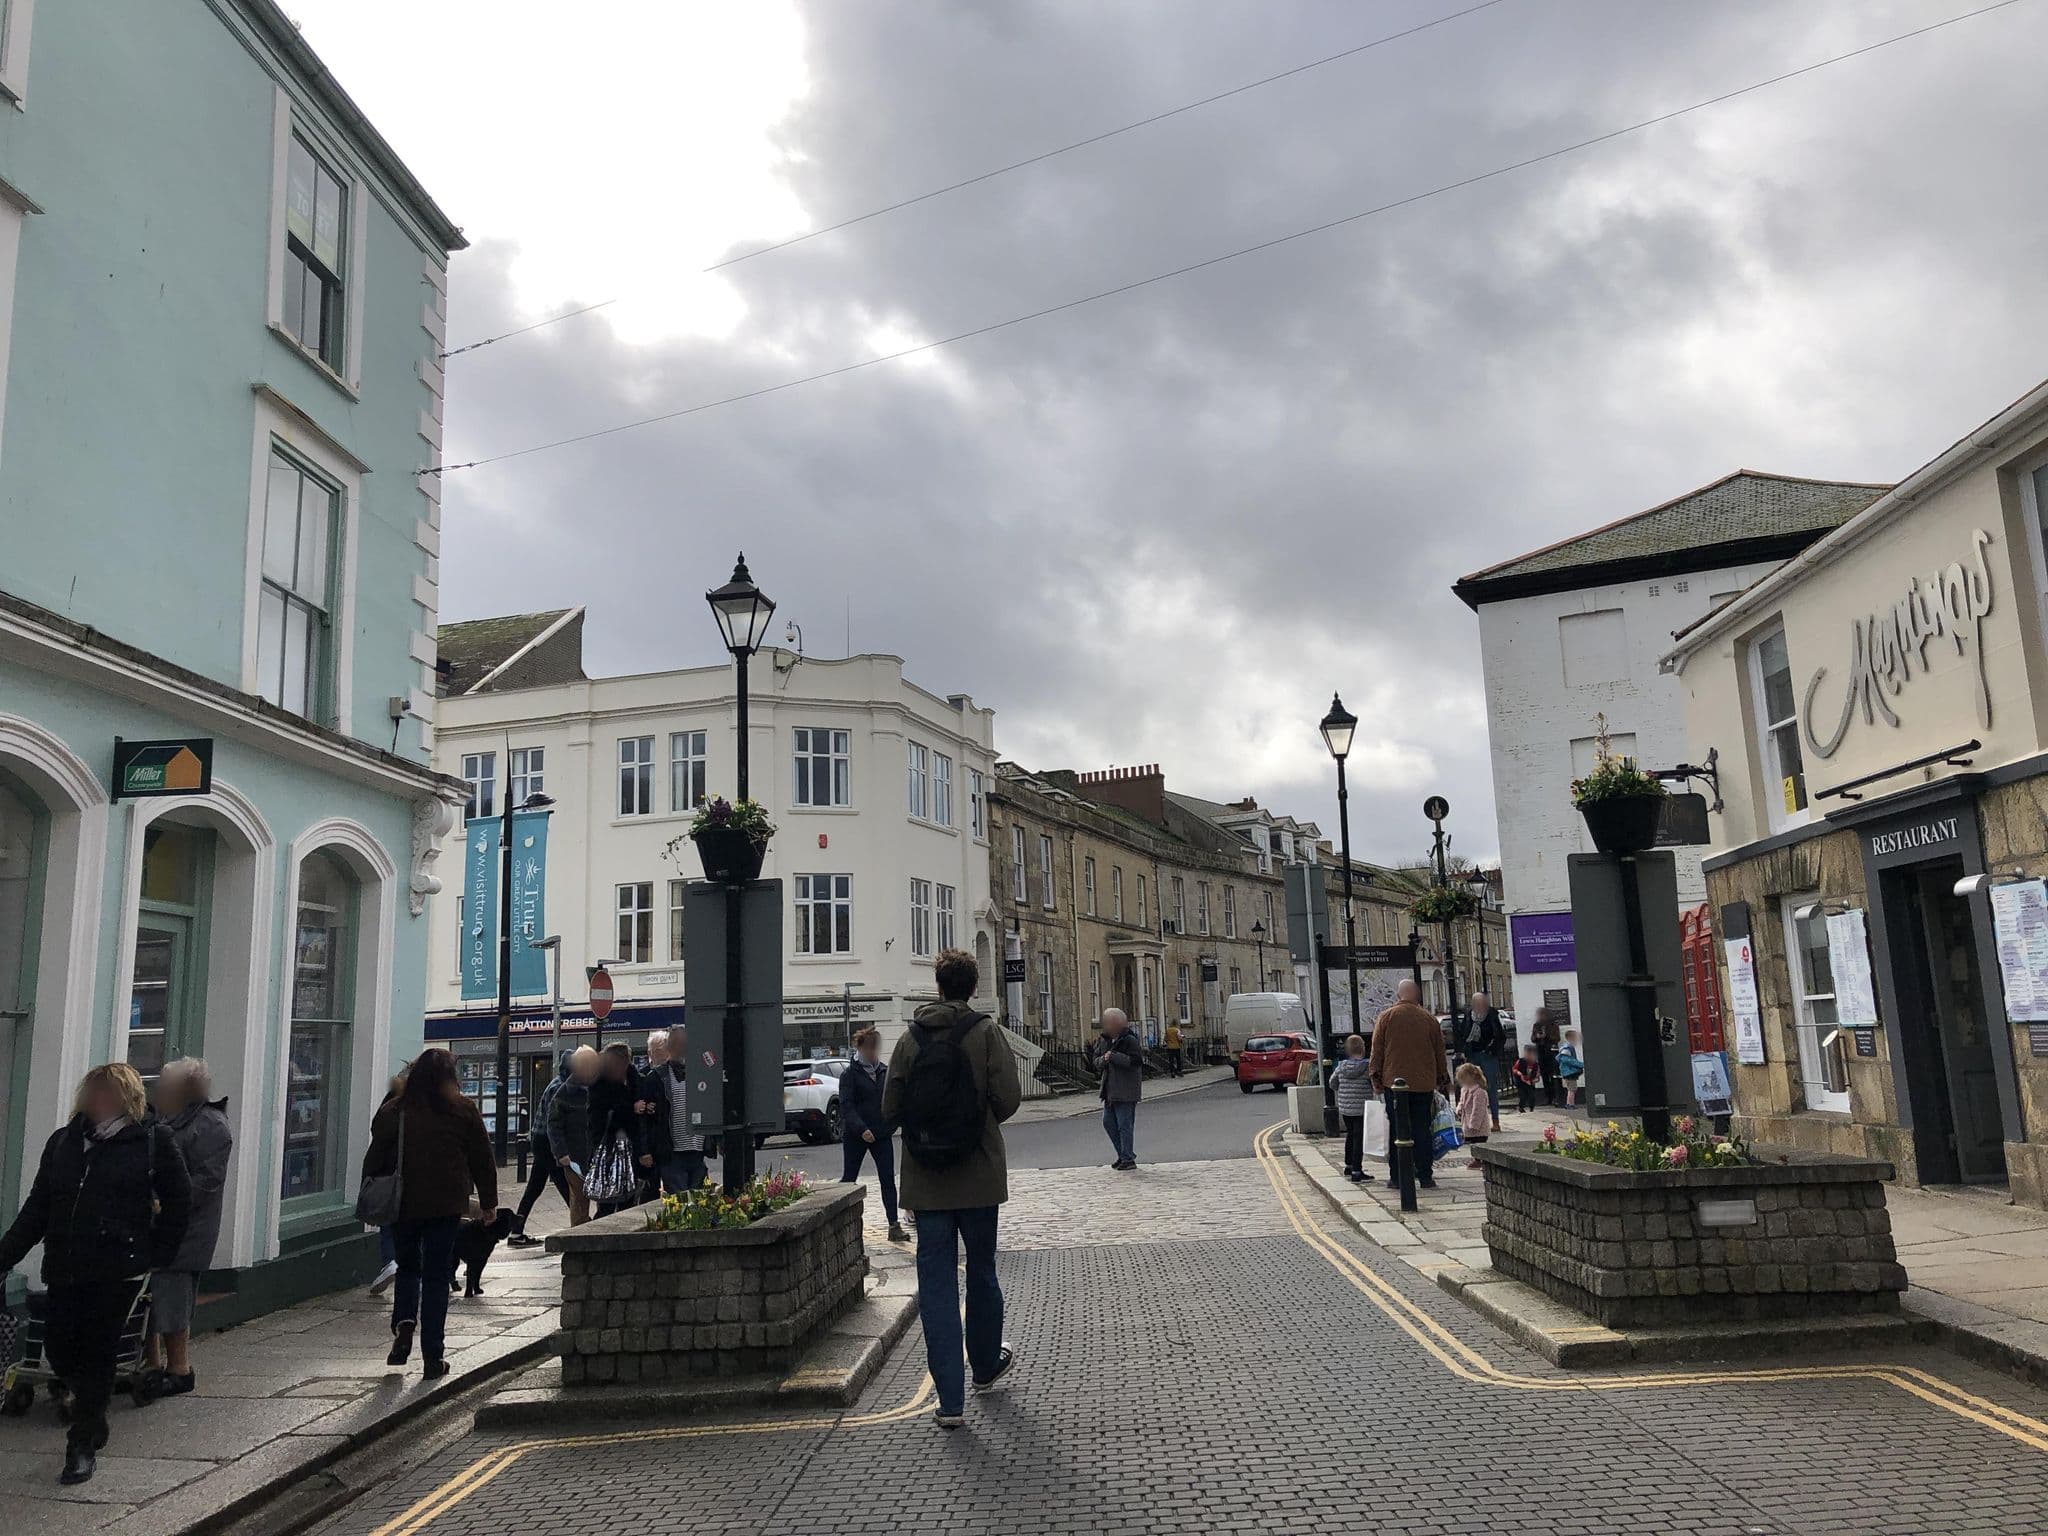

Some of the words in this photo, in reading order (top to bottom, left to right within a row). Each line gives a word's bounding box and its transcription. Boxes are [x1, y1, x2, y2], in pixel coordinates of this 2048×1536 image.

[1804, 528, 1990, 758] Mannings
[129, 767, 162, 782] Miller
[1872, 818, 1958, 856] RESTAURANT
[513, 880, 521, 905] GREAT
